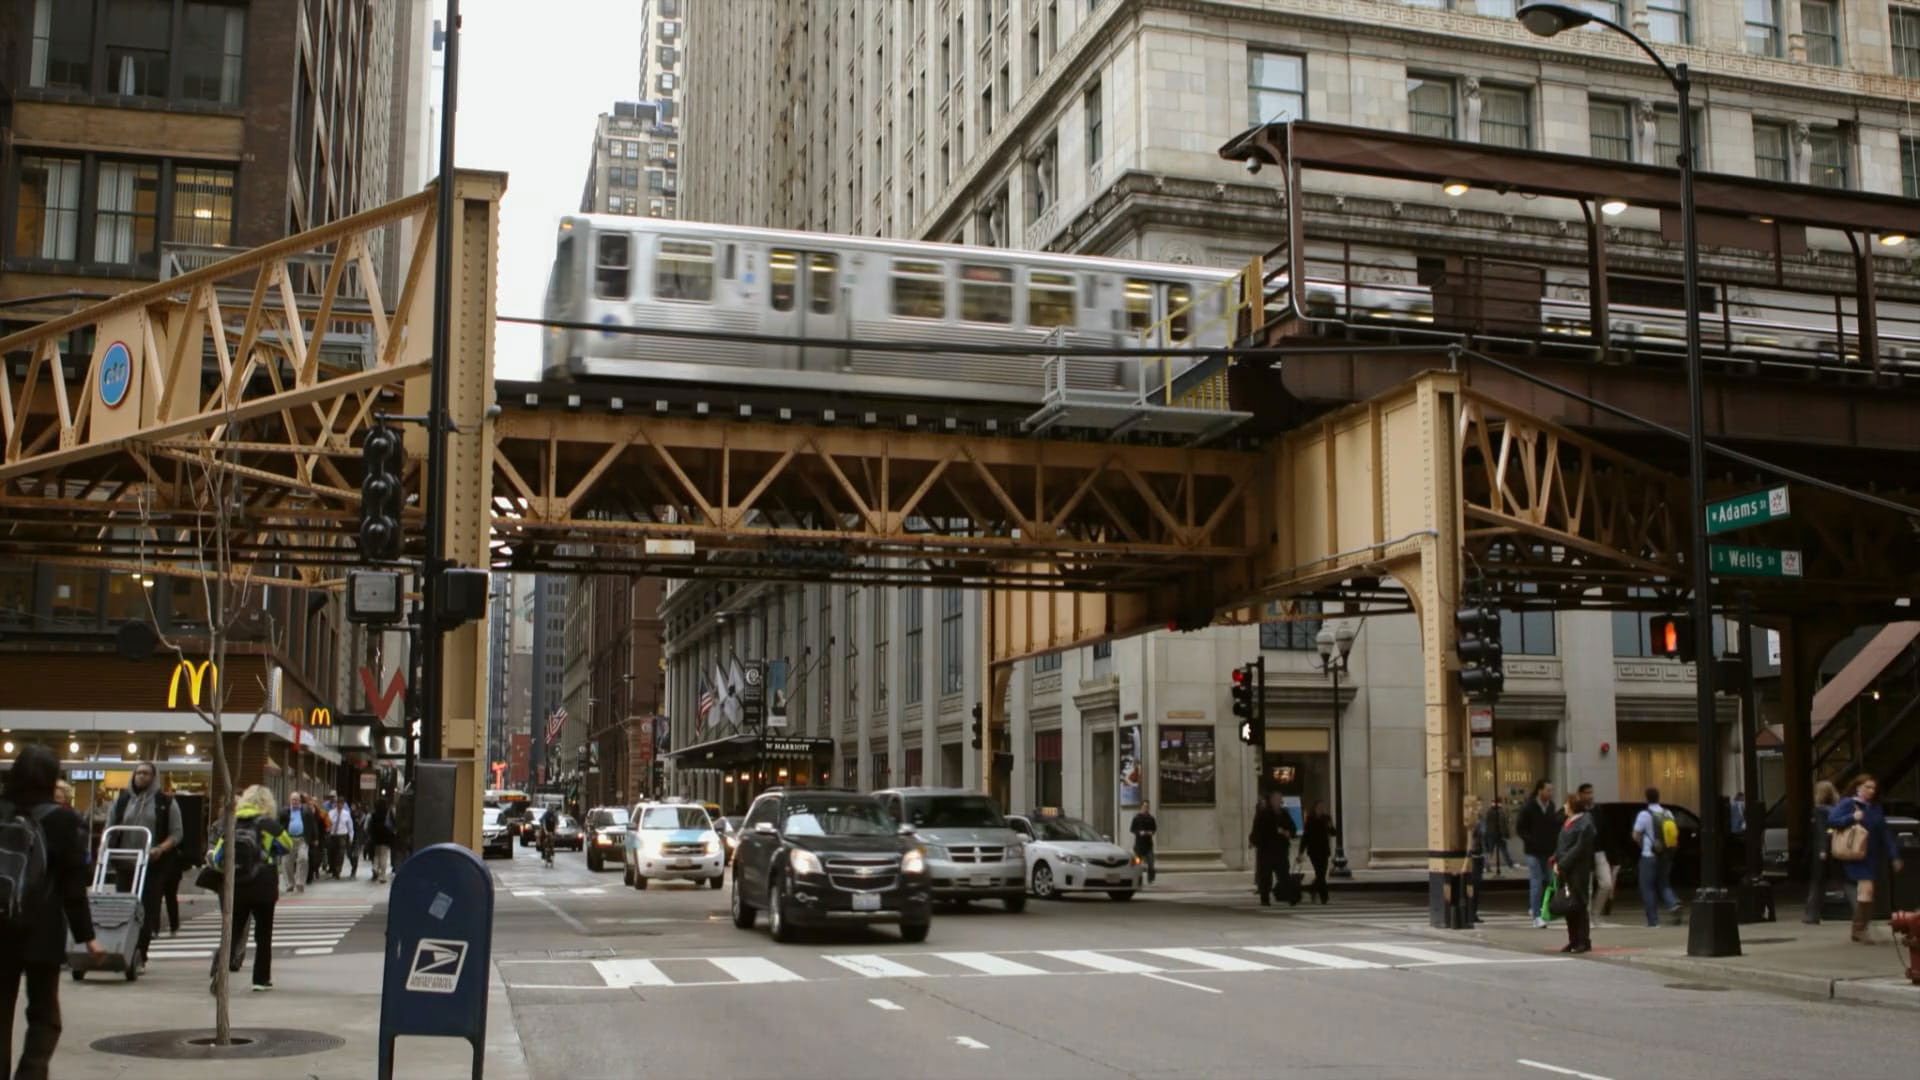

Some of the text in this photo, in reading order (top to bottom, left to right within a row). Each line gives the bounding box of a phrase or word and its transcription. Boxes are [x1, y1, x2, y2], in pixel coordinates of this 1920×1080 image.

[1719, 501, 1758, 523] Adams
[1728, 549, 1763, 569] Wells
[774, 743, 811, 751] MARRIOTT
